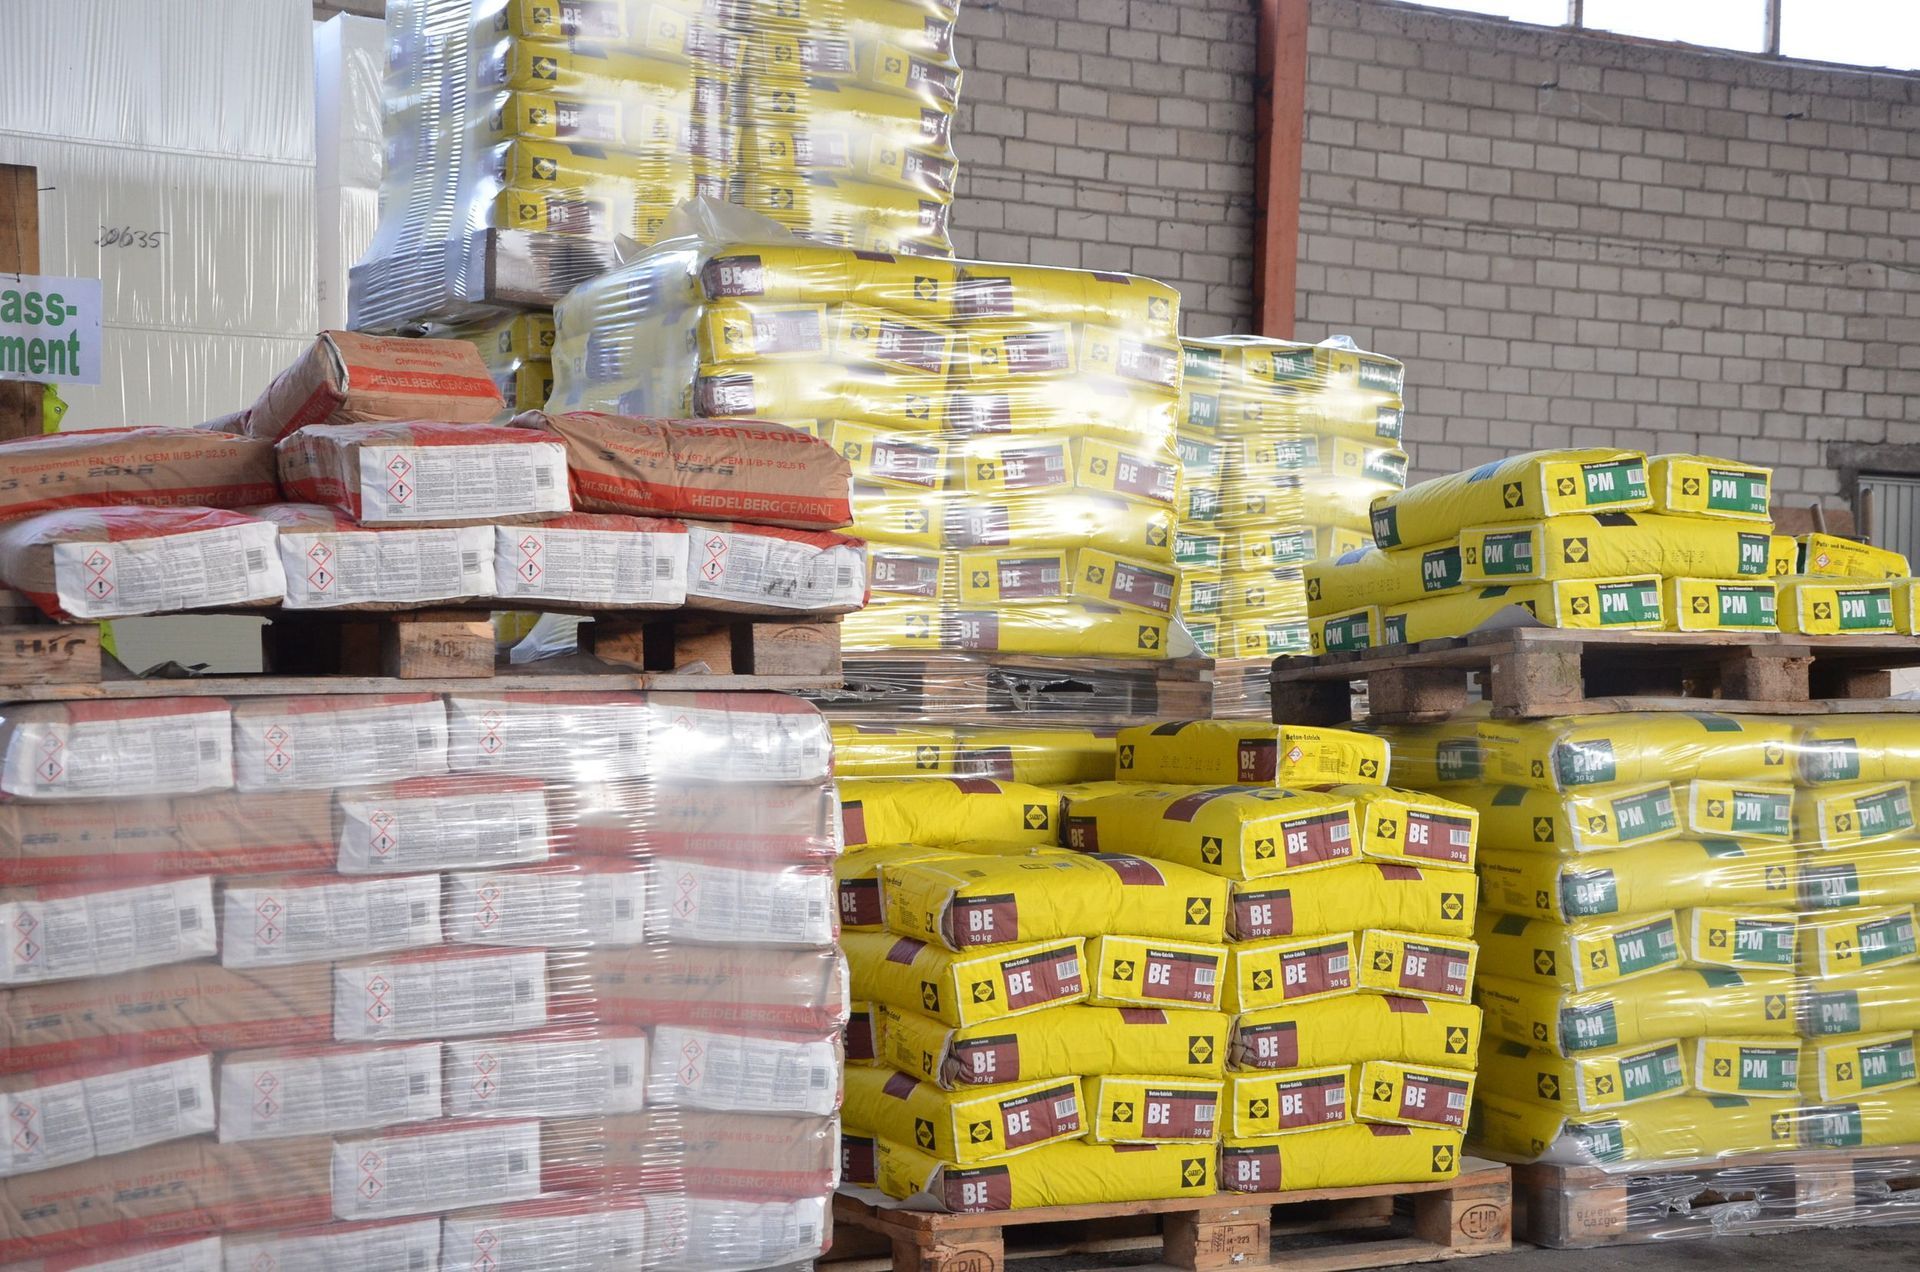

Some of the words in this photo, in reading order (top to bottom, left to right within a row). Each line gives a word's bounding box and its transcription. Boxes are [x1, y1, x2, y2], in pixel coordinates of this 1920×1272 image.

[911, 64, 928, 81] BE
[905, 156, 922, 172] BE
[371, 374, 482, 392] HEIDELBERGCEMENT
[1192, 401, 1210, 418] PM
[10, 458, 81, 476] Trasszement
[108, 453, 136, 465] 197-1
[144, 452, 170, 463] CEM
[172, 450, 202, 462] II/B-P
[205, 449, 228, 461] 32,5
[228, 448, 238, 458] R
[604, 440, 665, 459] Trasszement
[720, 456, 744, 467] CEM
[776, 461, 797, 471] 32,5
[798, 462, 806, 470] R
[874, 447, 896, 467] BE
[1178, 444, 1197, 461] PM
[1118, 463, 1138, 484] BE
[1587, 472, 1614, 493] PM
[1712, 479, 1737, 500] PM
[691, 493, 833, 517] HEIDELBERGCEMENT
[1374, 519, 1390, 539] PM
[1175, 538, 1196, 556] PM
[1484, 545, 1504, 564] PM
[1742, 543, 1764, 564] PM
[875, 561, 896, 581] BE
[1001, 570, 1021, 587] BE
[1424, 560, 1447, 580] PM
[1114, 572, 1135, 593] BE
[1602, 592, 1629, 613] PM
[1722, 595, 1748, 614] PM
[1841, 599, 1866, 618] PM
[961, 621, 980, 639] BE
[1269, 630, 1289, 646] PM
[1325, 627, 1344, 646] PM
[1240, 750, 1257, 770] BE
[1821, 751, 1848, 769] PM
[1618, 805, 1646, 829] PM
[1736, 801, 1761, 821] PM
[1861, 804, 1885, 826] PM
[1070, 828, 1085, 847] BE
[1287, 831, 1308, 854] BE
[1409, 823, 1428, 845] BE
[1332, 847, 1341, 856] 30
[1341, 846, 1349, 857] kg
[1450, 850, 1459, 859] 30
[1459, 852, 1467, 862] kg
[1821, 877, 1848, 897] PM
[841, 892, 857, 913] BE
[969, 908, 994, 932] BE
[1250, 904, 1272, 926] BE
[970, 934, 980, 943] 30
[981, 933, 992, 944] kg
[1252, 928, 1261, 936] 30
[1261, 927, 1271, 937] kg
[1738, 930, 1763, 950] PM
[1861, 931, 1886, 953] PM
[1618, 938, 1645, 963] PM
[1148, 963, 1171, 986] BE
[1285, 962, 1308, 986] BE
[1405, 955, 1427, 977] BE
[1008, 971, 1033, 996] BE
[1060, 984, 1069, 994] 30
[1069, 983, 1079, 994] kg
[1330, 979, 1340, 988] 30
[1339, 978, 1348, 987] kg
[1446, 983, 1454, 992] 30
[1454, 985, 1463, 995] kg
[1193, 991, 1202, 999] 30
[1202, 991, 1211, 1001] kg
[1822, 1003, 1848, 1023] PM
[1575, 1016, 1605, 1039] PM
[1257, 1036, 1278, 1058] BE
[972, 1050, 996, 1074] BE
[1266, 1059, 1276, 1068] kg
[1743, 1059, 1768, 1079] PM
[1862, 1055, 1887, 1076] PM
[973, 1076, 983, 1084] 30
[983, 1075, 993, 1084] kg
[1624, 1064, 1651, 1089] PM
[1282, 1093, 1303, 1116] BE
[1405, 1085, 1427, 1108] BE
[1007, 1110, 1031, 1135] BE
[1147, 1103, 1170, 1125] BE
[1325, 1111, 1335, 1120] 30
[1334, 1109, 1343, 1120] kg
[1445, 1113, 1453, 1122] 30
[1453, 1115, 1462, 1125] kg
[1057, 1123, 1066, 1132] 30
[1066, 1121, 1077, 1132] kg
[1202, 1128, 1211, 1137] kg
[1823, 1117, 1850, 1136] PM
[1238, 1160, 1261, 1182] BE
[962, 1181, 988, 1205] BE
